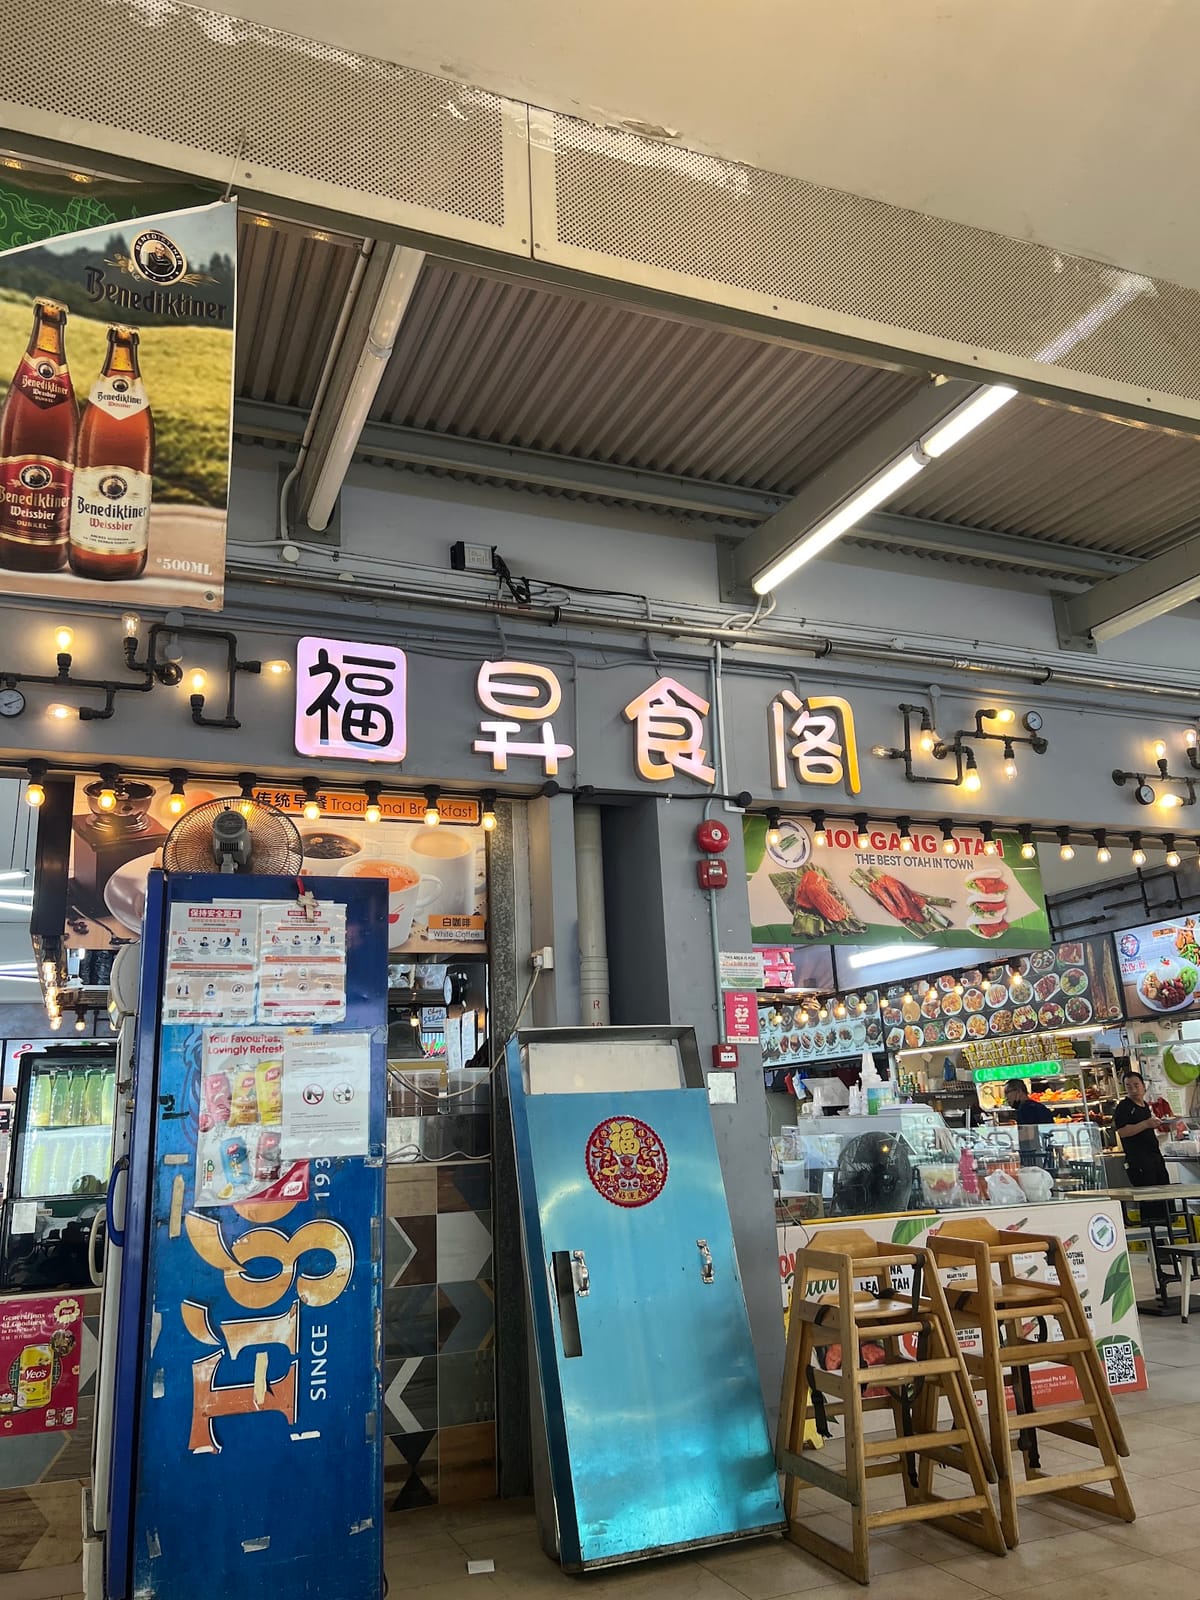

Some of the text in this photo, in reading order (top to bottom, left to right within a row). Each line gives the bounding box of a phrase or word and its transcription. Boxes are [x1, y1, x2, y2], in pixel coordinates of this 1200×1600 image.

[84, 265, 228, 320] Benediktiner
[22, 375, 68, 395] Benediktiner
[10, 505, 55, 520] Weissbier
[77, 495, 147, 520] Benediktiner
[90, 517, 133, 531] Weissbier
[855, 853, 974, 870] THE BEST OTAH IN TOWN
[208, 1045, 248, 1055] Lovingly
[891, 1278, 910, 1290] TAH
[309, 1322, 329, 1401] SINCE
[25, 1369, 47, 1380] Yeo's
